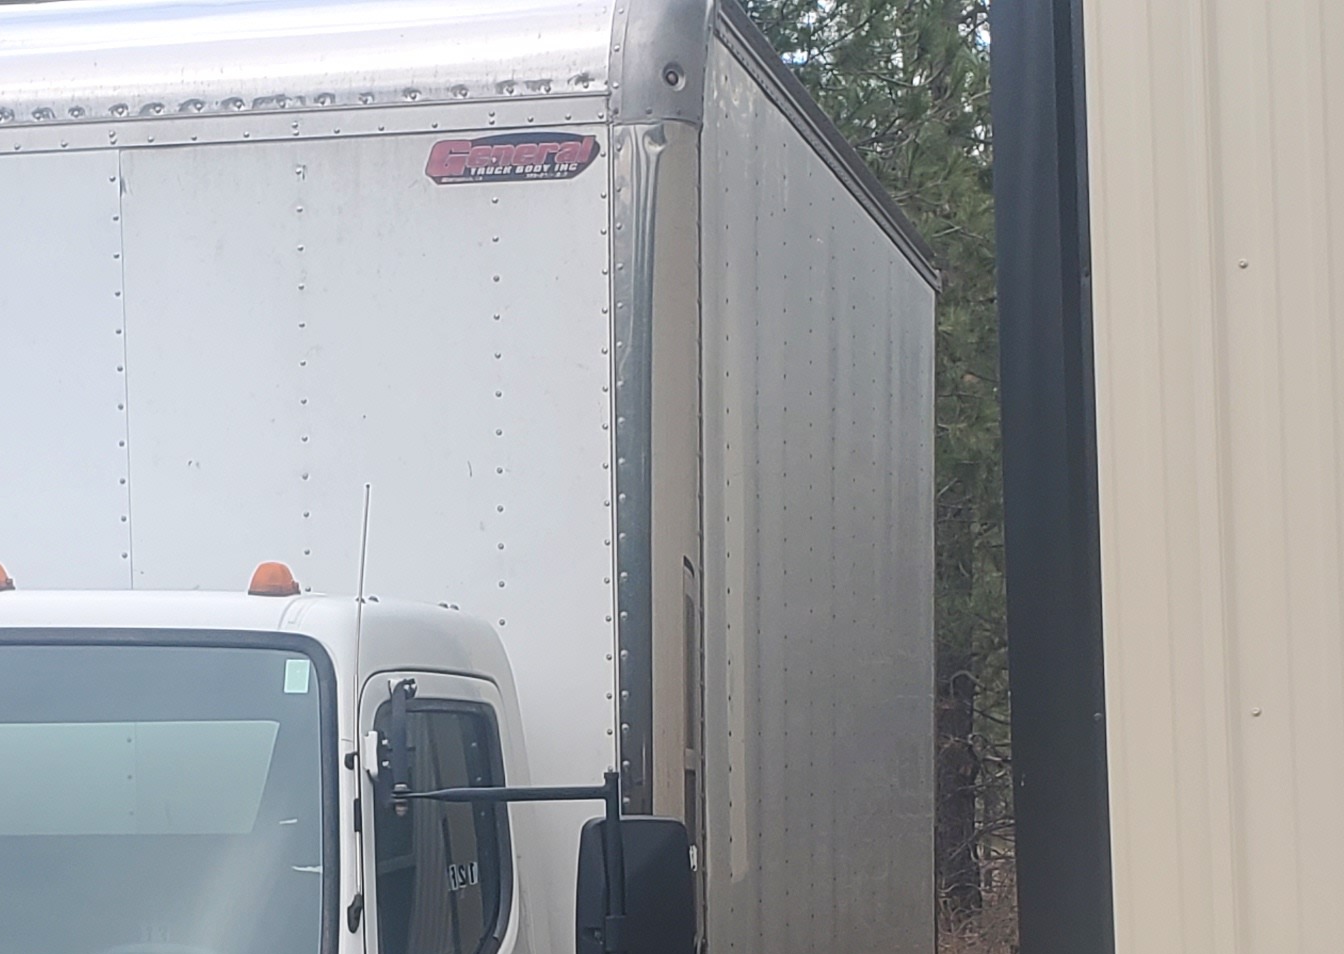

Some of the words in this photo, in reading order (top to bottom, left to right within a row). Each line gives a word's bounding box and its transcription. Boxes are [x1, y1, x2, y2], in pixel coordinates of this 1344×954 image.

[425, 135, 596, 178] General
[469, 165, 512, 176] TRUCK
[515, 164, 552, 175] BODY
[553, 162, 578, 172] INC
